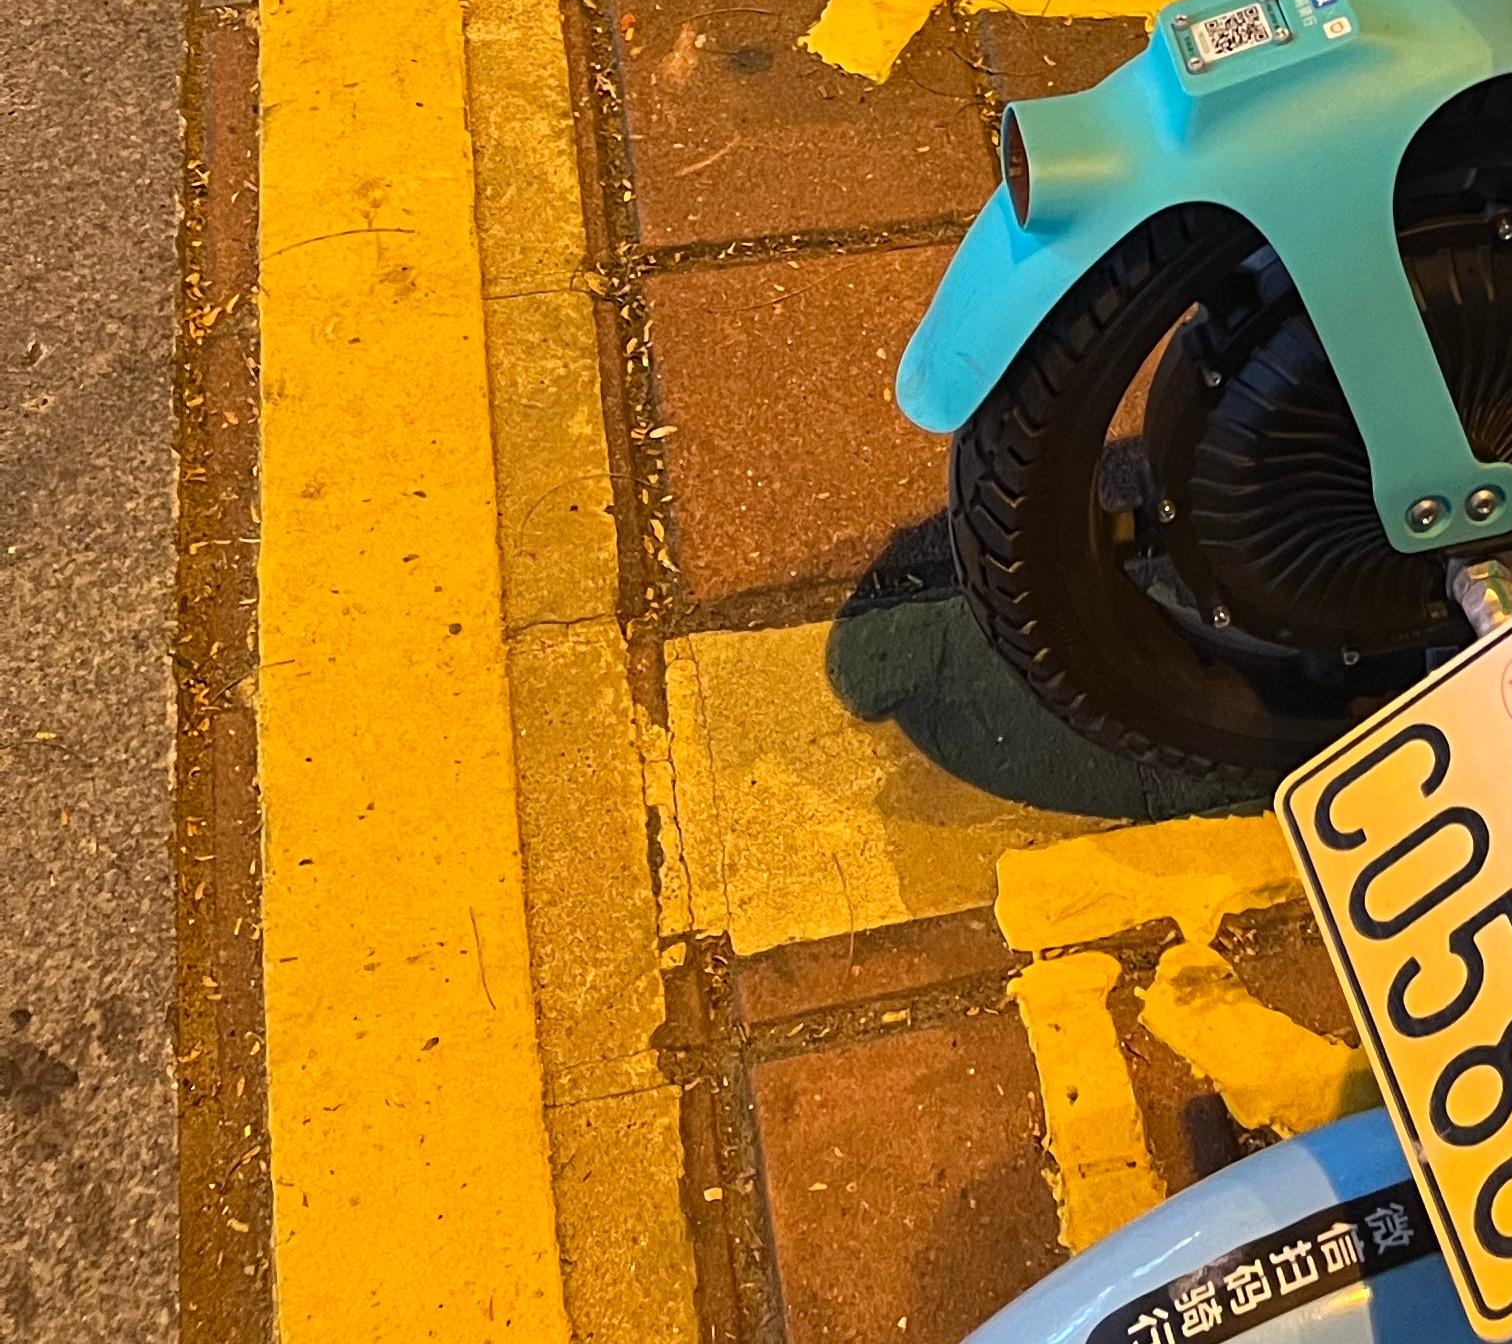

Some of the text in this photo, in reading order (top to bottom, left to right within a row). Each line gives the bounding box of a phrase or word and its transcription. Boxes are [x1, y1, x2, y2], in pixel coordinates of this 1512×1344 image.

[1128, 1202, 1416, 1344] 微信扫码骑行
